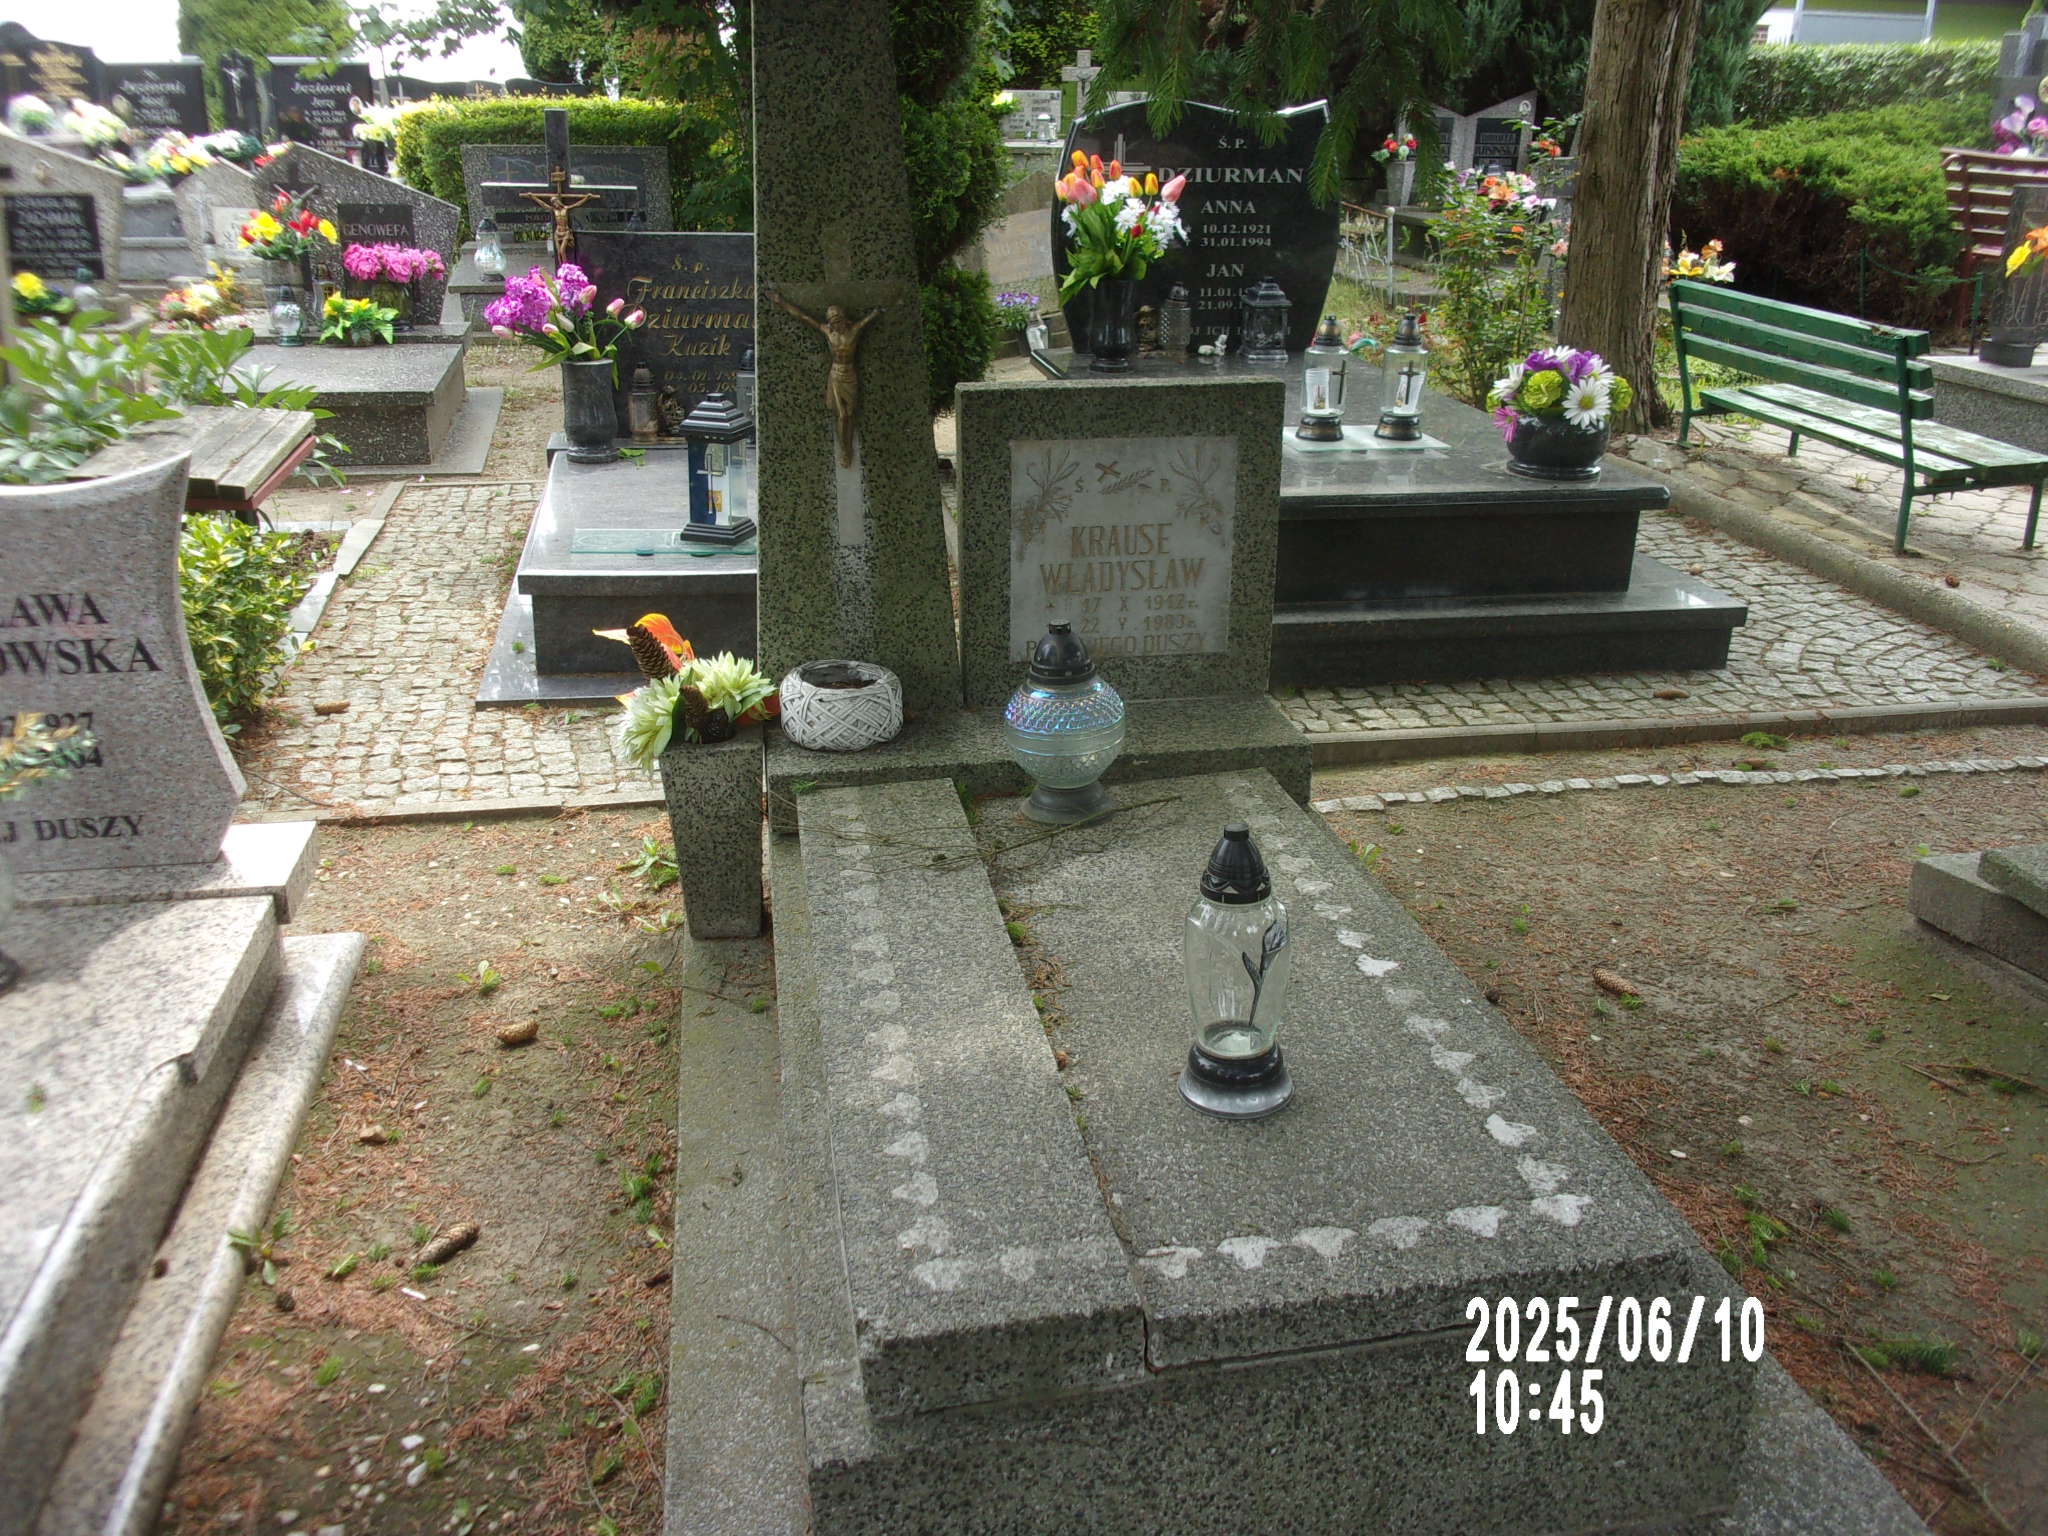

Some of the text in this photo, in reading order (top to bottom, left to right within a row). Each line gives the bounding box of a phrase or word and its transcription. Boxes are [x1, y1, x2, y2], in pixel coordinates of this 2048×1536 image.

[1158, 167, 1305, 184] DZIURMAN
[1200, 200, 1257, 215] ANNA
[343, 223, 410, 236] GENOWEFA
[1202, 224, 1271, 234] 10.12.1921
[1200, 237, 1271, 247] 31.01.1994
[1206, 263, 1245, 278] JAN
[1070, 522, 1173, 558] KRAUSE
[0, 591, 109, 629] AWA
[34, 815, 144, 842] DUSZY
